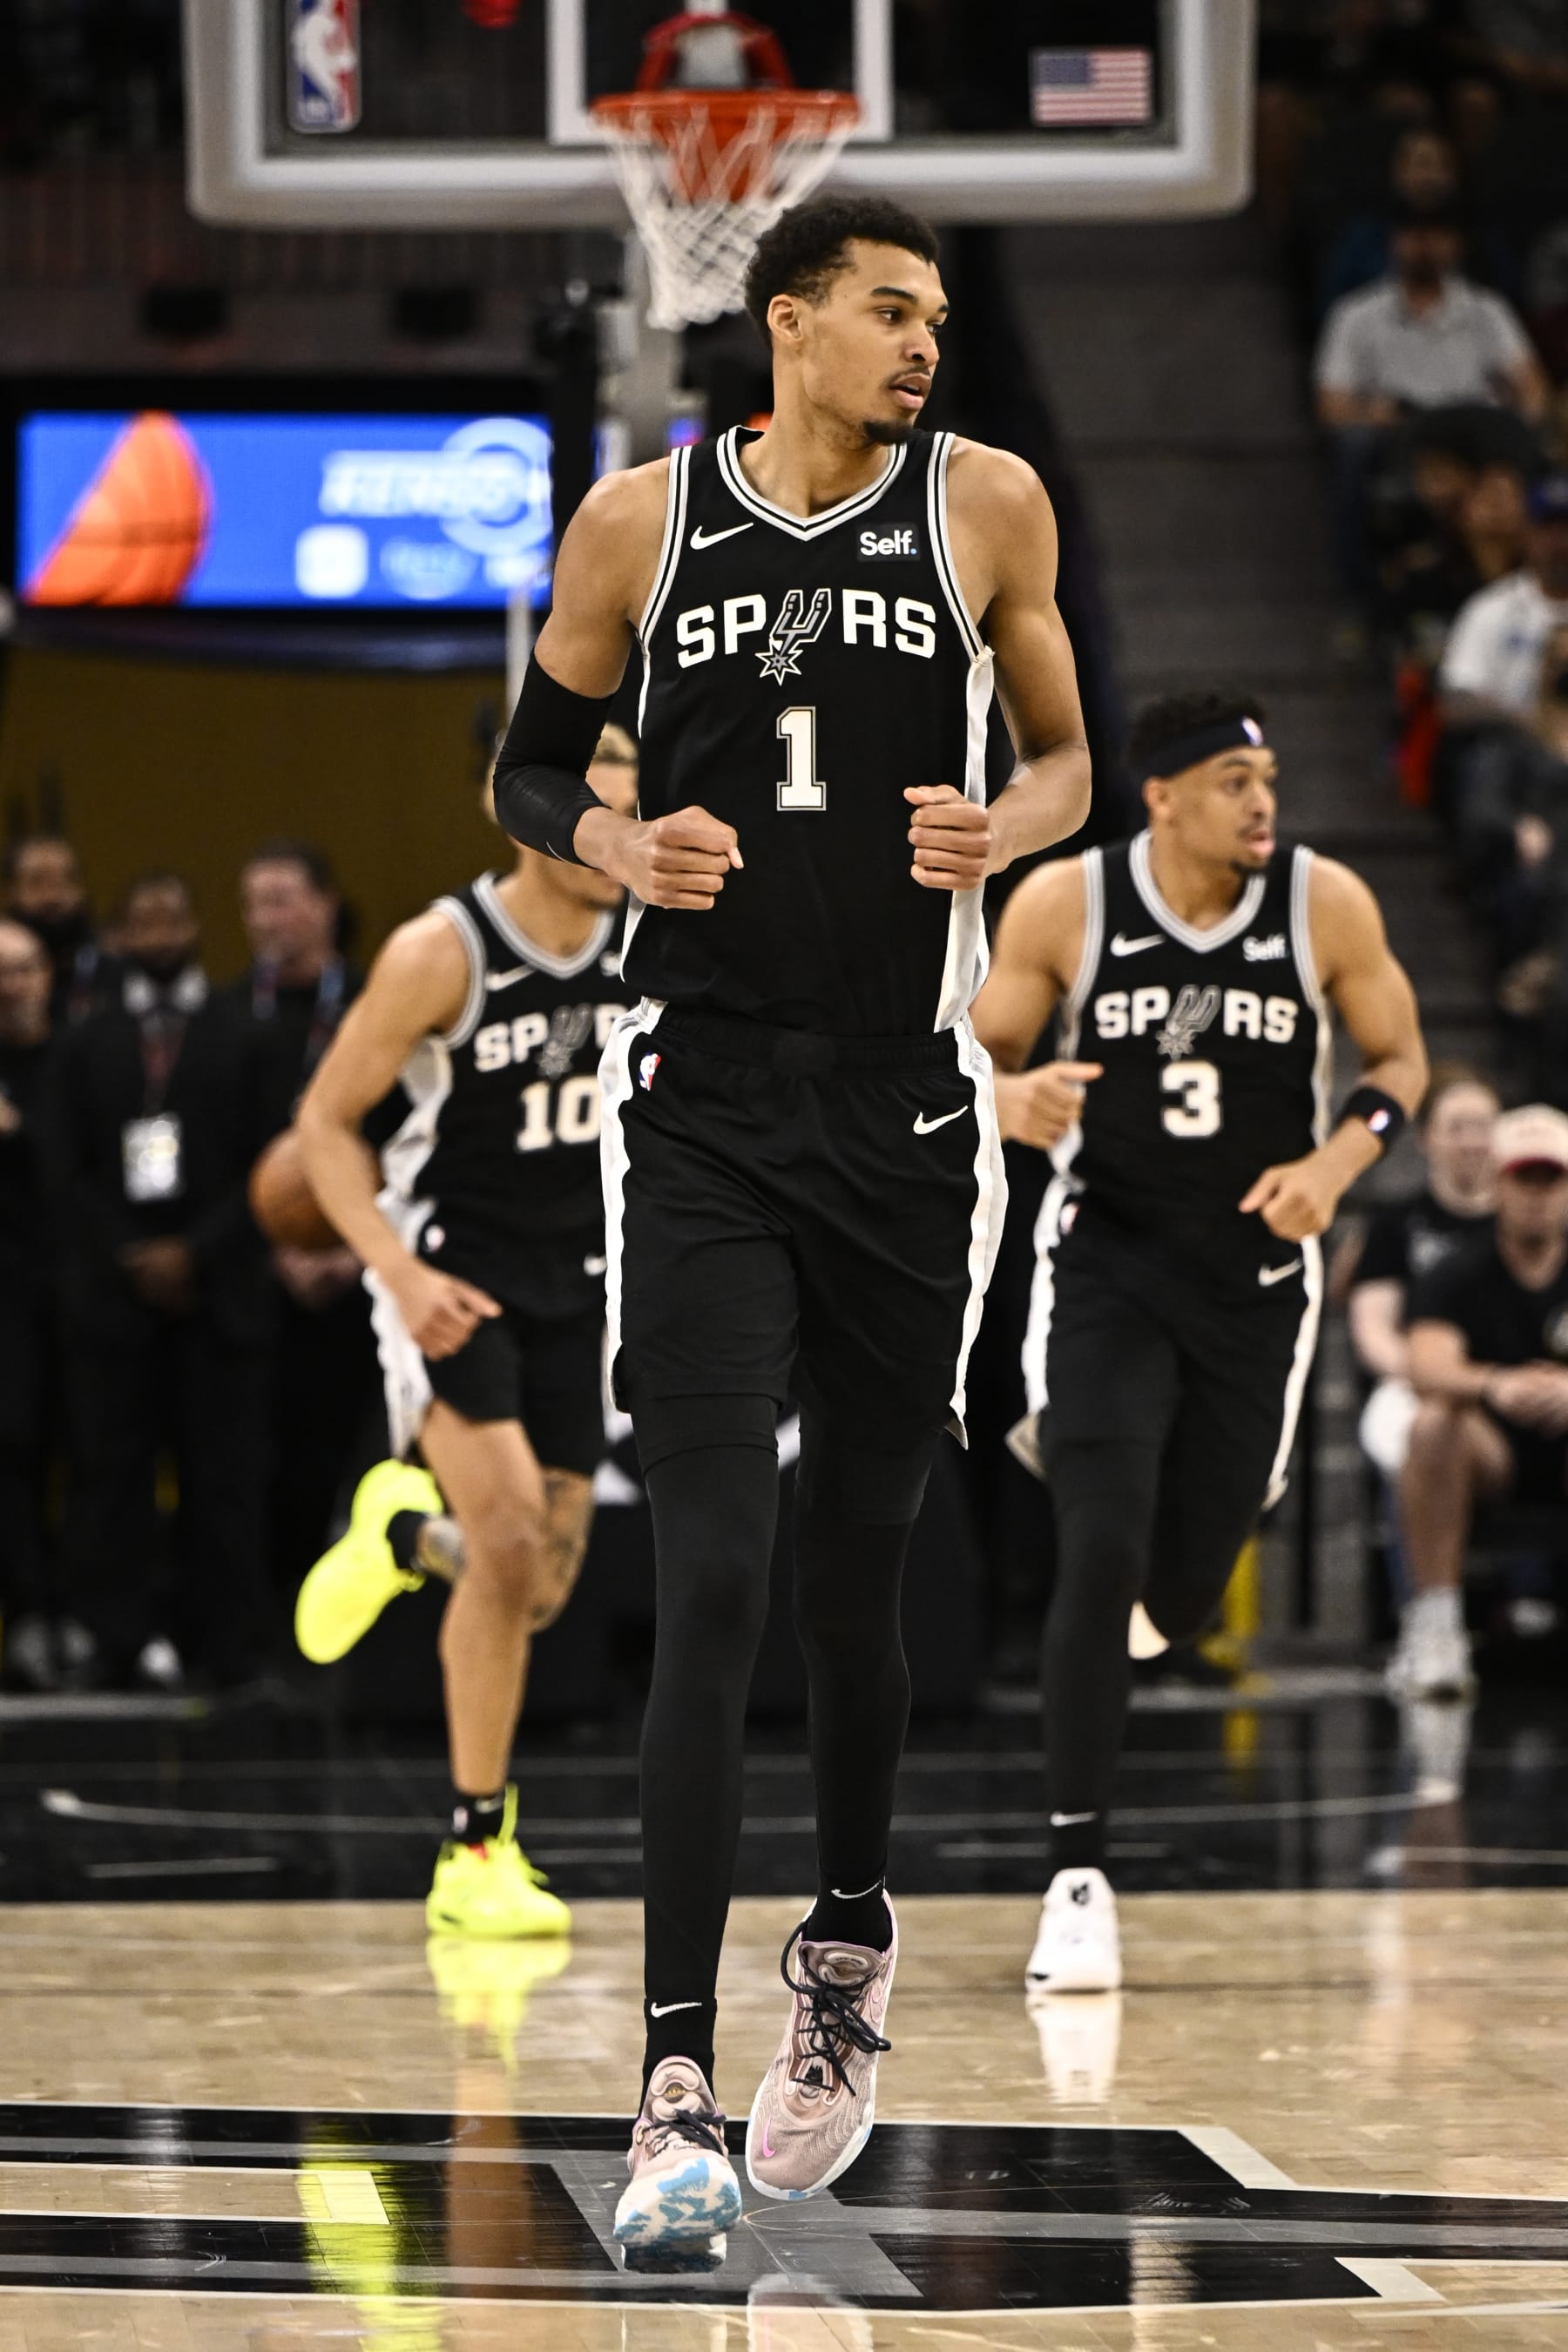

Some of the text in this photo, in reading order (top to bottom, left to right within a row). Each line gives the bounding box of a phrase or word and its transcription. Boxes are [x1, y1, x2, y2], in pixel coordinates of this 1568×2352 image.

[860, 530, 917, 556] Self.
[676, 588, 936, 686] SPURS
[776, 706, 827, 812] 1
[1094, 984, 1299, 1060] SPURS
[516, 1075, 601, 1152] 10
[1160, 1060, 1223, 1138] 3
